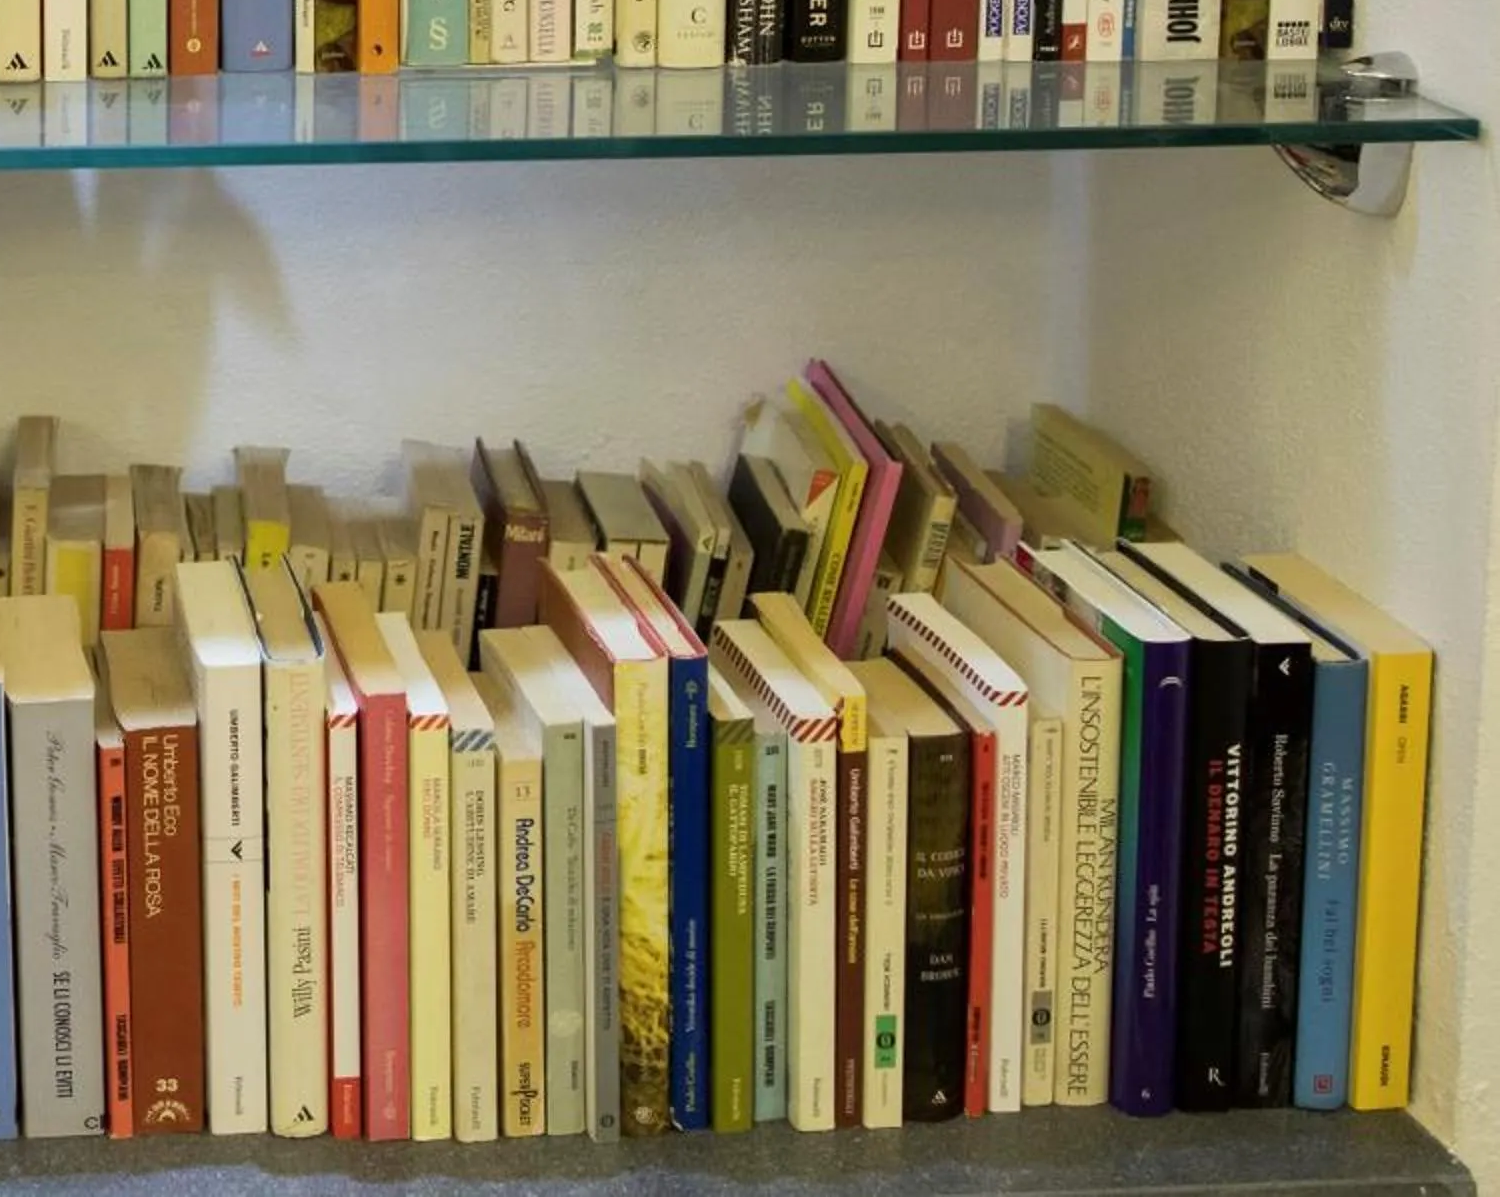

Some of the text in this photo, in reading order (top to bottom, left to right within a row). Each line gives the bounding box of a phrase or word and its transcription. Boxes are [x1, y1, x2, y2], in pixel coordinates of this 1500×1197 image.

[162, 734, 180, 837] Umberto Eco
[1270, 734, 1287, 785] Roberto
[143, 735, 162, 918] IL NOME DELLA ROSA
[515, 817, 534, 871] Andrea
[1202, 759, 1223, 954] IL DENARO IN TESTA
[1219, 742, 1241, 967] VITTORINO ANDREOLI
[1268, 789, 1285, 843] Saviano
[1268, 853, 1281, 869] La
[1316, 761, 1336, 882] GRAMELLINI
[1338, 777, 1353, 865] MASSIMO
[1068, 675, 1102, 1095] L'INSOSTENIBILE LEGGEREZZA DELL'ESSERE
[1094, 797, 1117, 973] MILAN KUNDERA
[291, 927, 313, 1019] Willy Pasini
[1261, 954, 1277, 1009] bambini
[1264, 931, 1277, 951] dei
[52, 971, 74, 1099] SE LI CONOSCI LI EVITI
